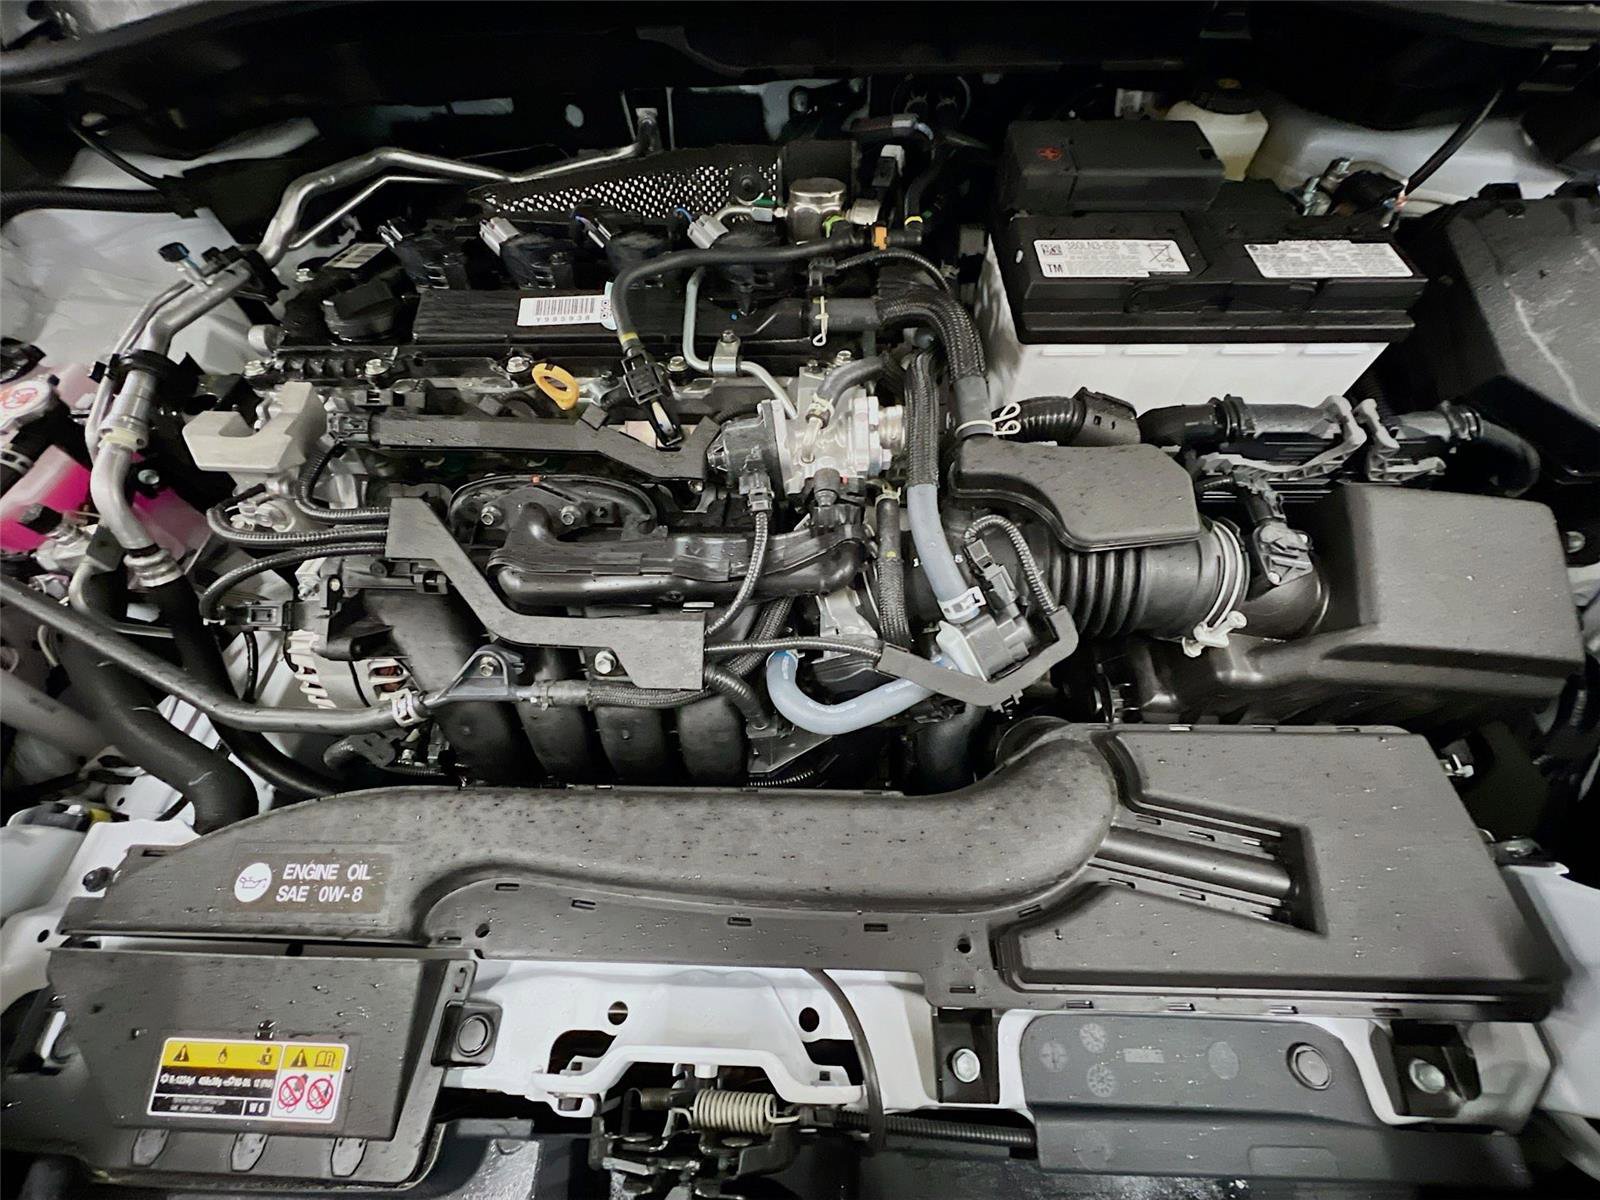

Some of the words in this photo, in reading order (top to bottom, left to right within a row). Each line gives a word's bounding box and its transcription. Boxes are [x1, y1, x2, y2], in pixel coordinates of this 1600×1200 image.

[1048, 263, 1063, 273] TM
[282, 863, 340, 881] ENGINE
[346, 863, 373, 881] OIL
[276, 885, 310, 902] SAE
[318, 886, 364, 903] 0W-8
